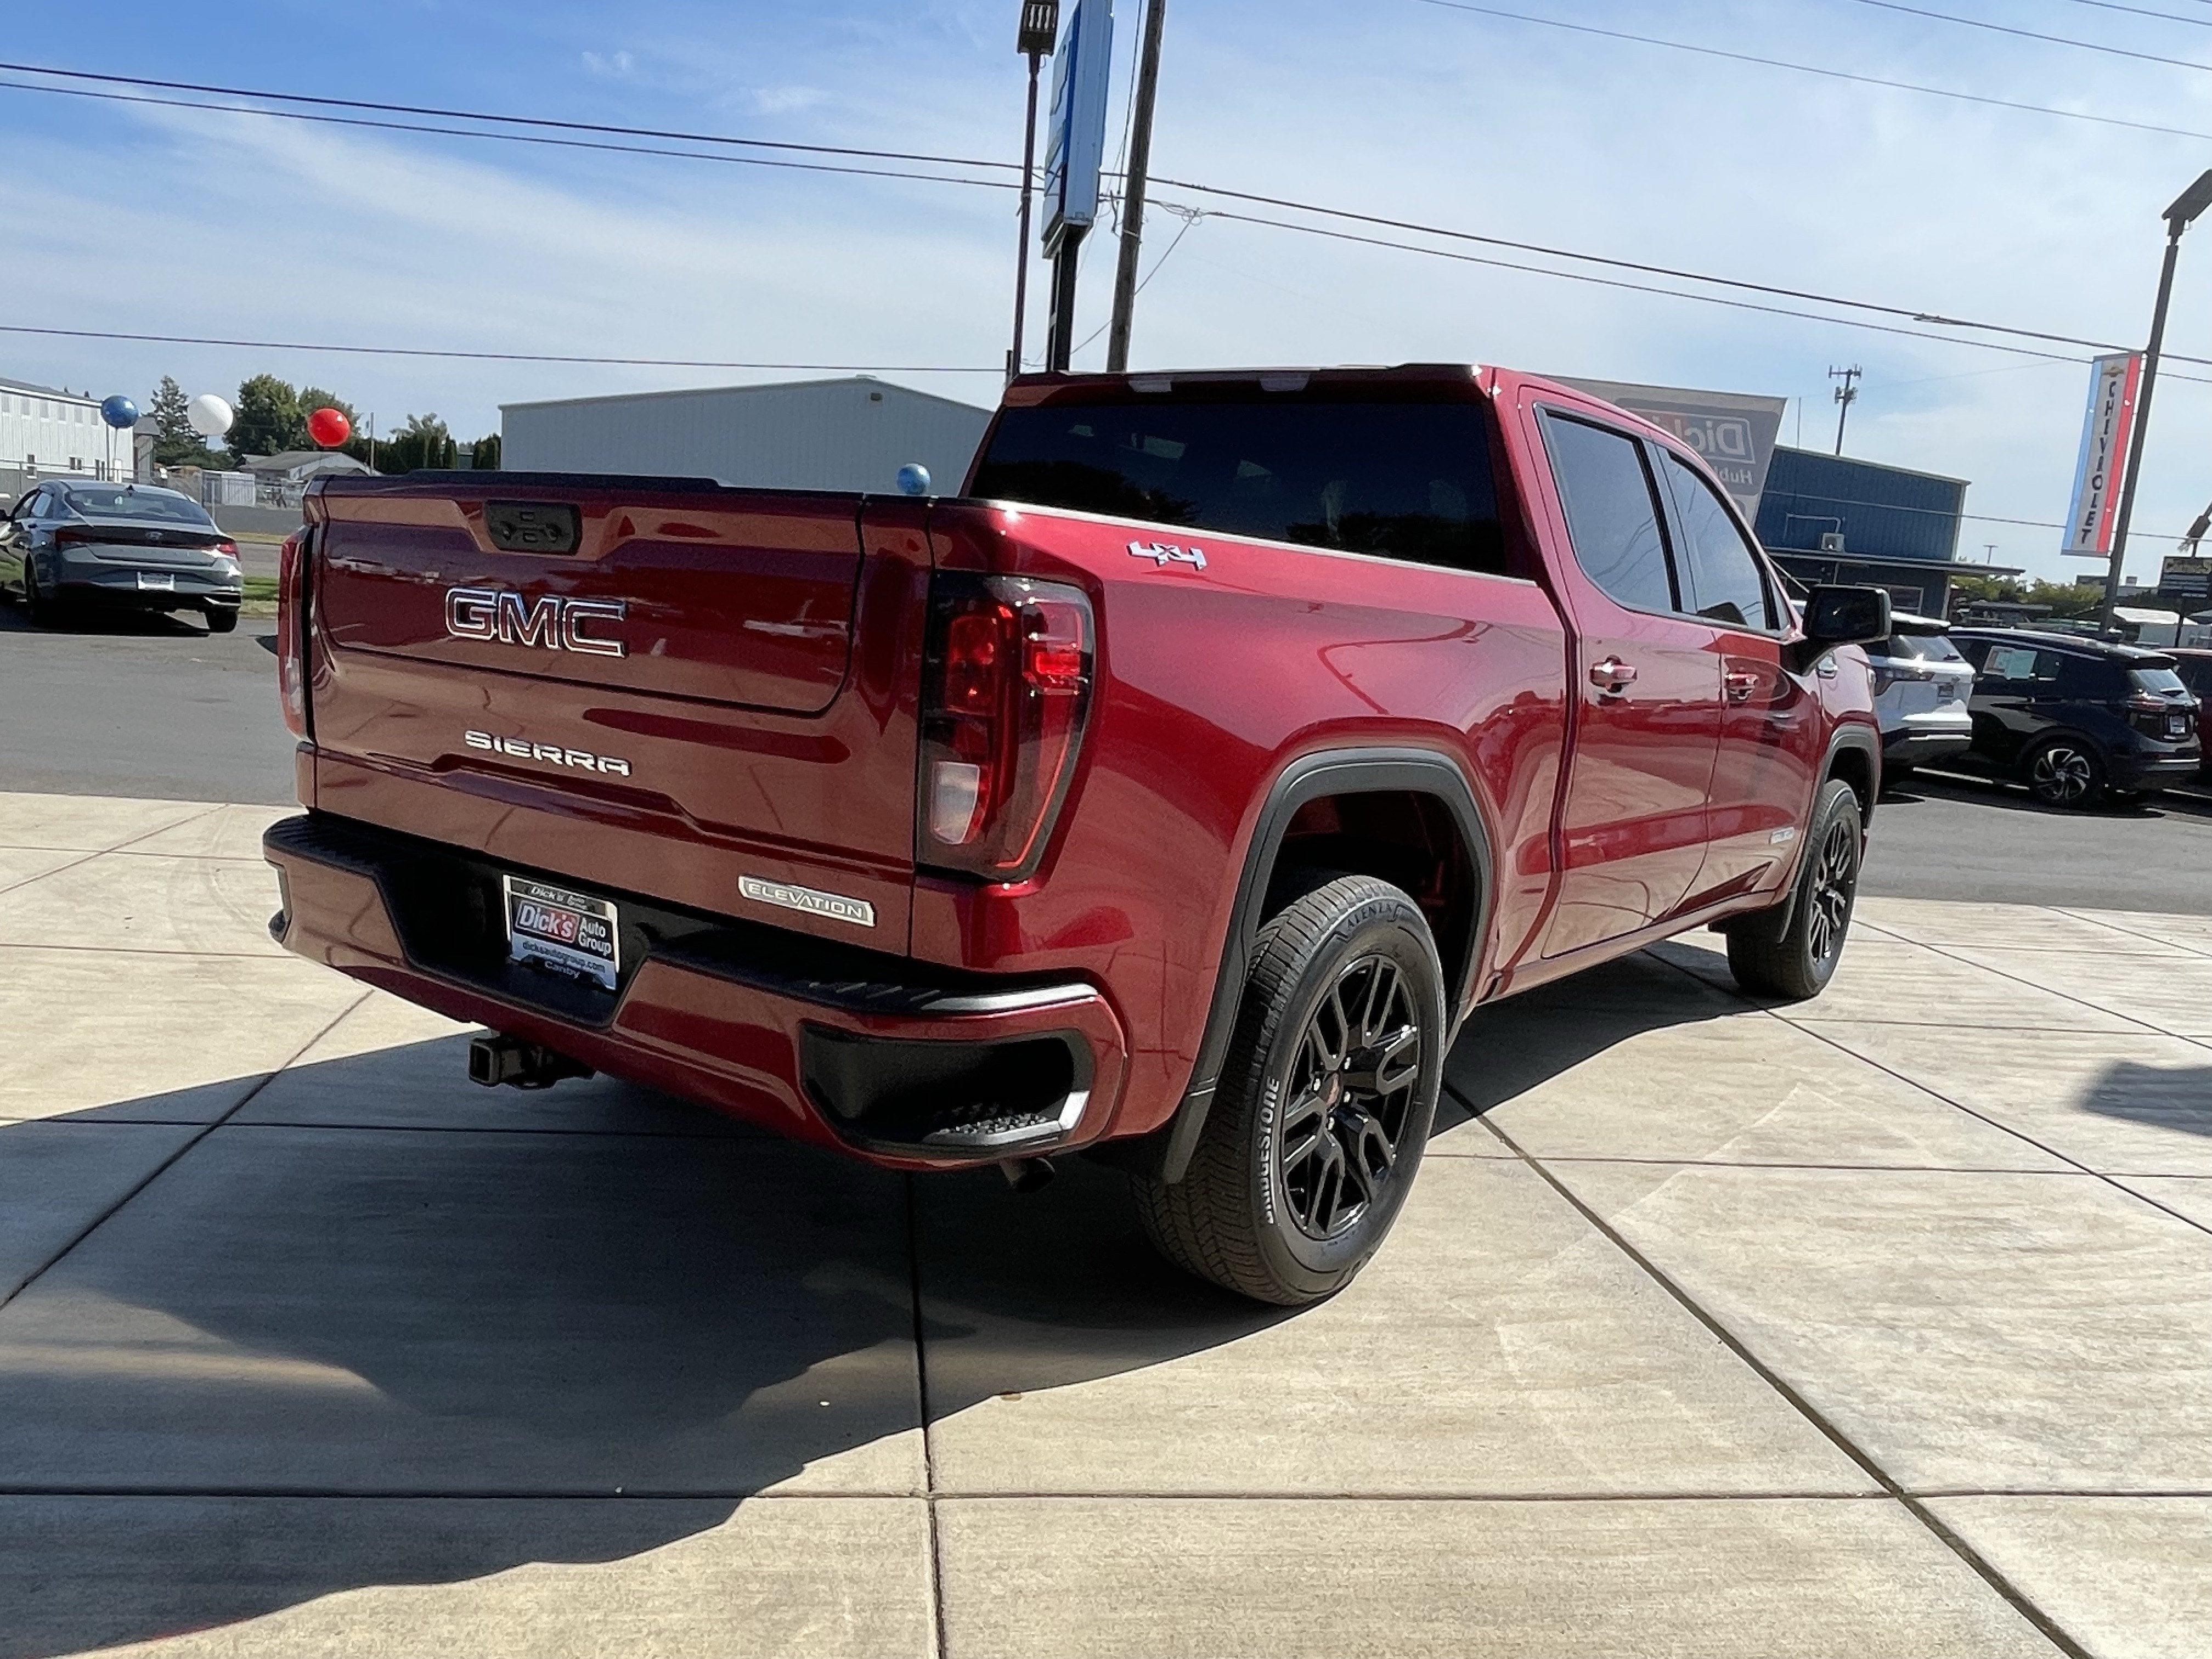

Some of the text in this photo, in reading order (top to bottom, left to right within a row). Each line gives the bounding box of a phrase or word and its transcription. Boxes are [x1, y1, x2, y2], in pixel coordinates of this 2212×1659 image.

[445, 586, 626, 658] GMC
[465, 730, 631, 776] SIERRA
[748, 883, 862, 918] ELEVATION
[520, 905, 573, 938] Dick's
[579, 917, 606, 938] Auto
[578, 932, 612, 957] Group
[1257, 1075, 1280, 1224] BRIDGESTONE
